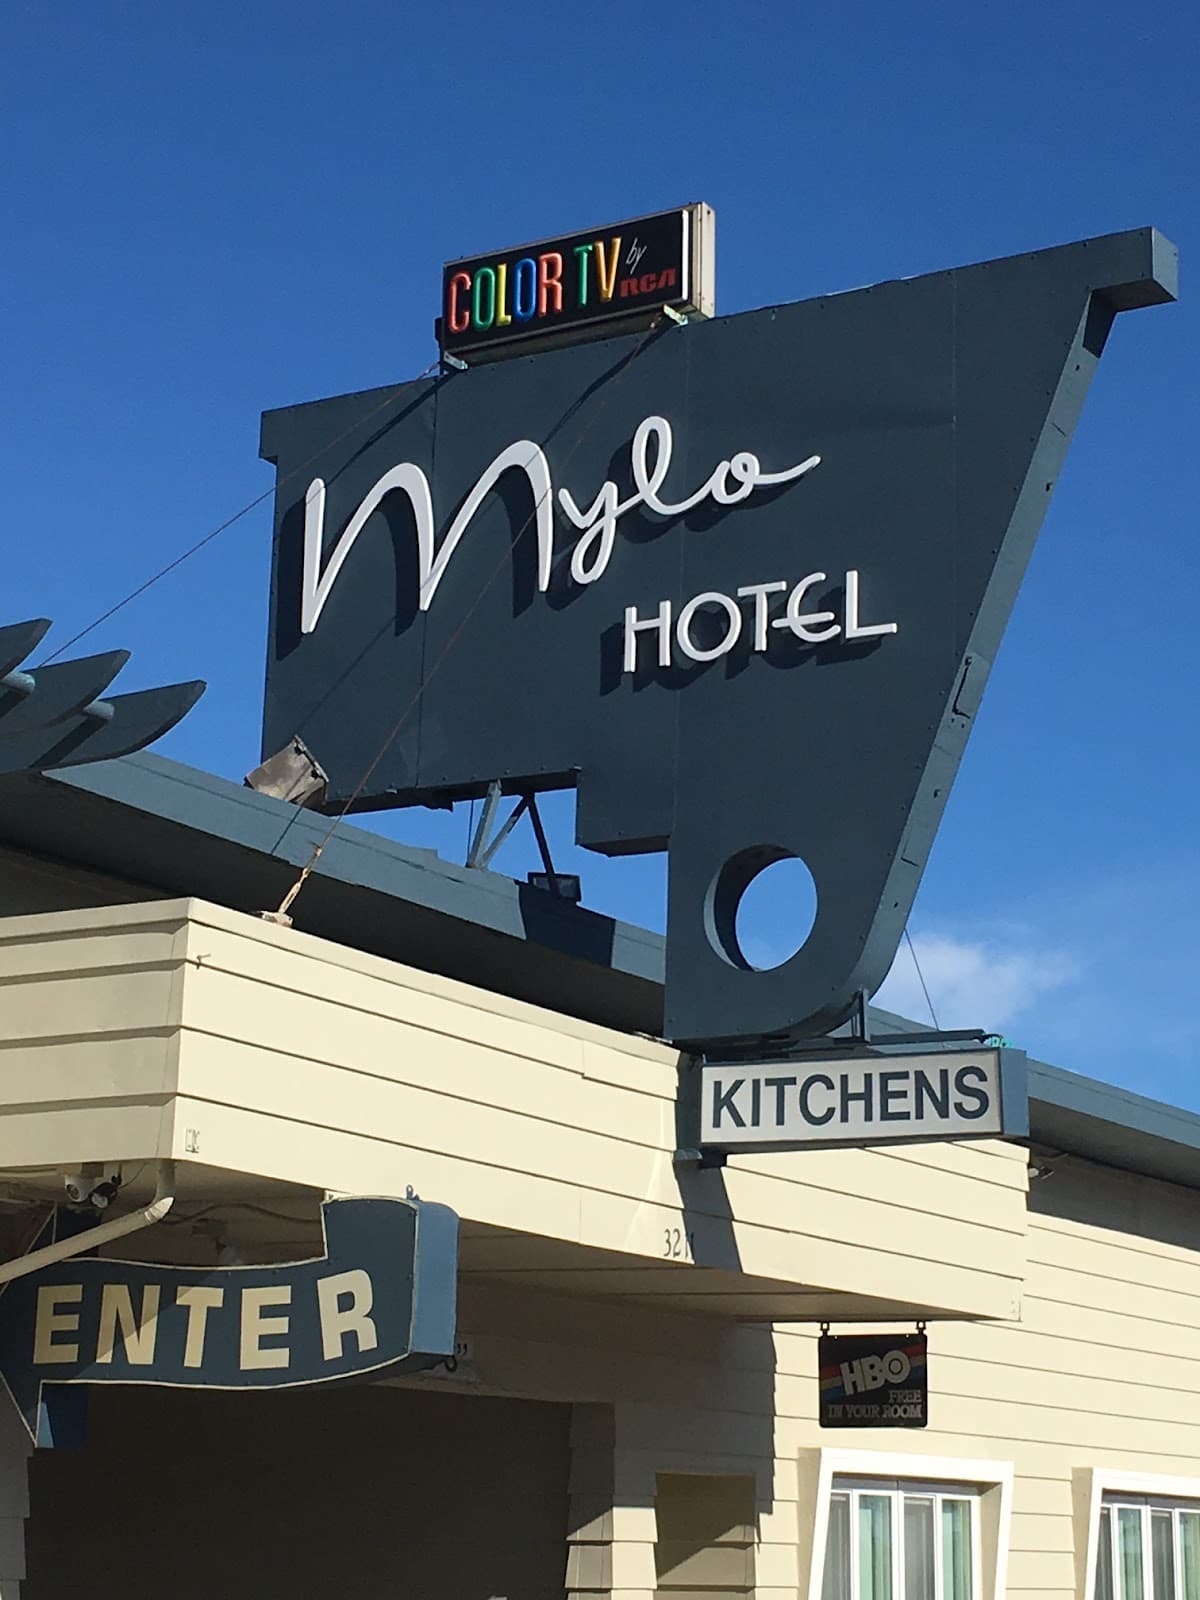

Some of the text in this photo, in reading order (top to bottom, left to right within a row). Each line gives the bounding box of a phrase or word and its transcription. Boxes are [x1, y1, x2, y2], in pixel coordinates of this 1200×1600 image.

[448, 236, 648, 333] COLOR TV by
[300, 415, 822, 634] Mylo
[624, 570, 898, 673] HOTEL
[711, 1065, 990, 1129] KITCHENS
[32, 1268, 379, 1371] ENTER
[827, 1404, 923, 1419] IN YOUR ROOM
[840, 1350, 911, 1396] HBO
[888, 1389, 923, 1404] FREE
